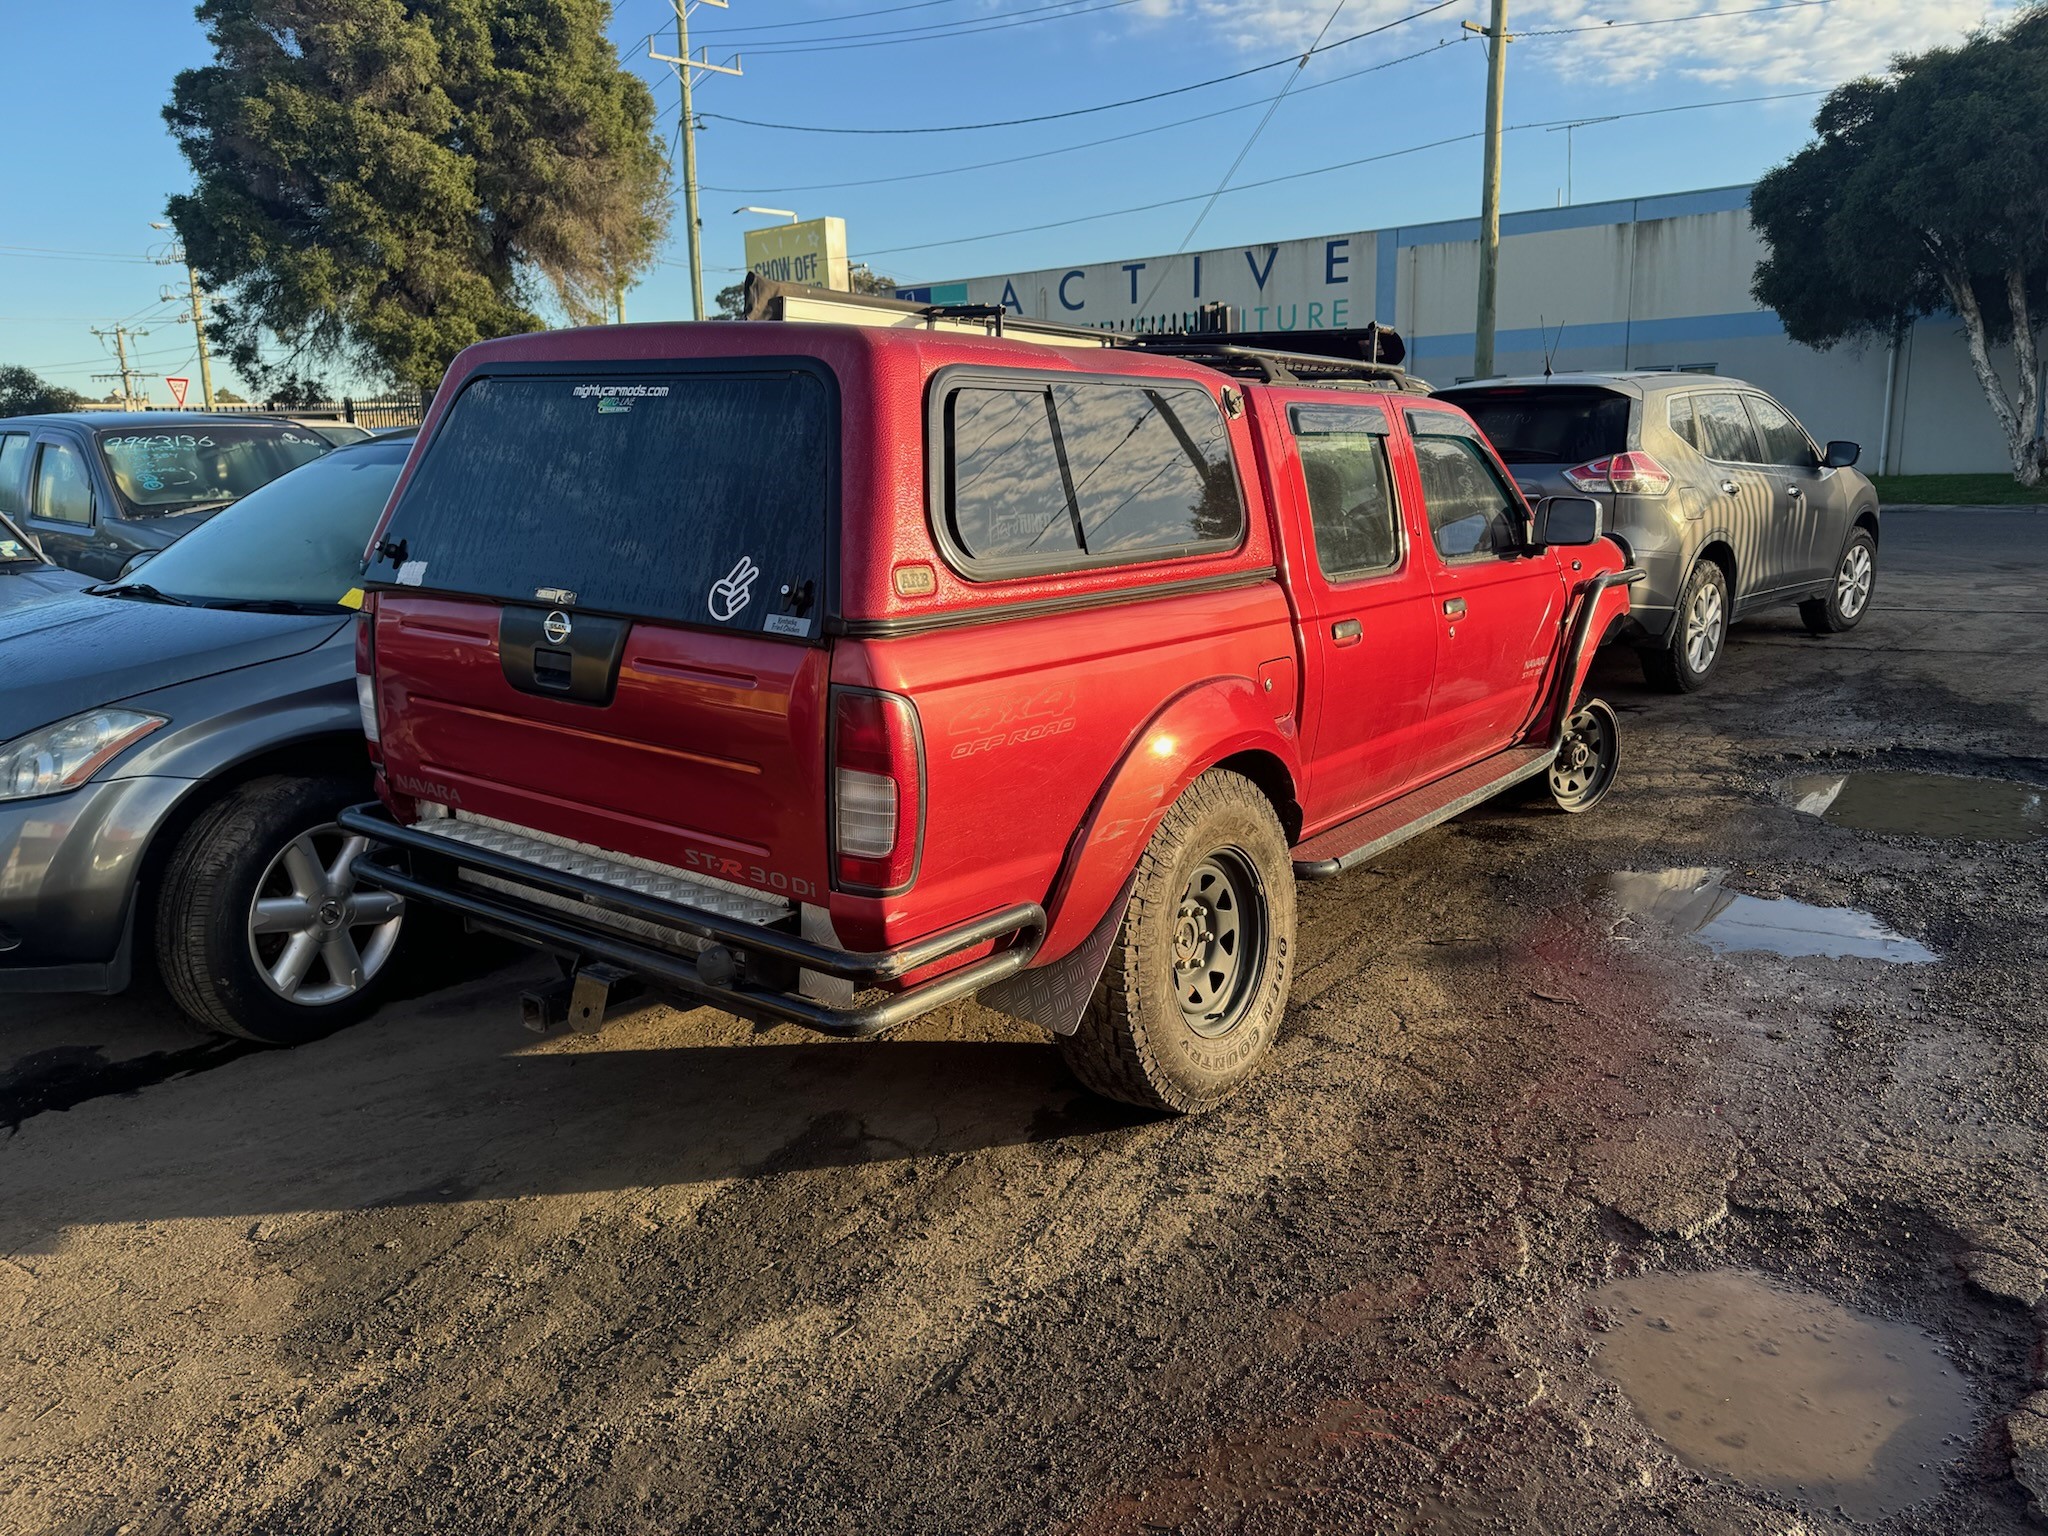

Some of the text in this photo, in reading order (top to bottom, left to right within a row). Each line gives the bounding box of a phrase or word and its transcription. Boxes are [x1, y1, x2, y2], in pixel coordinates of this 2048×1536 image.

[754, 253, 818, 282] SHOW OFF
[1000, 239, 1350, 316] ACTIVE
[572, 384, 670, 399] mightycarmods.com
[106, 434, 216, 451] 7943136
[901, 572, 930, 589] ARB
[951, 717, 1076, 760] OFF ROAD
[395, 774, 463, 804] NAVARA
[1260, 935, 1288, 1027] OPEN
[1178, 1026, 1261, 1072] COUNTRY
